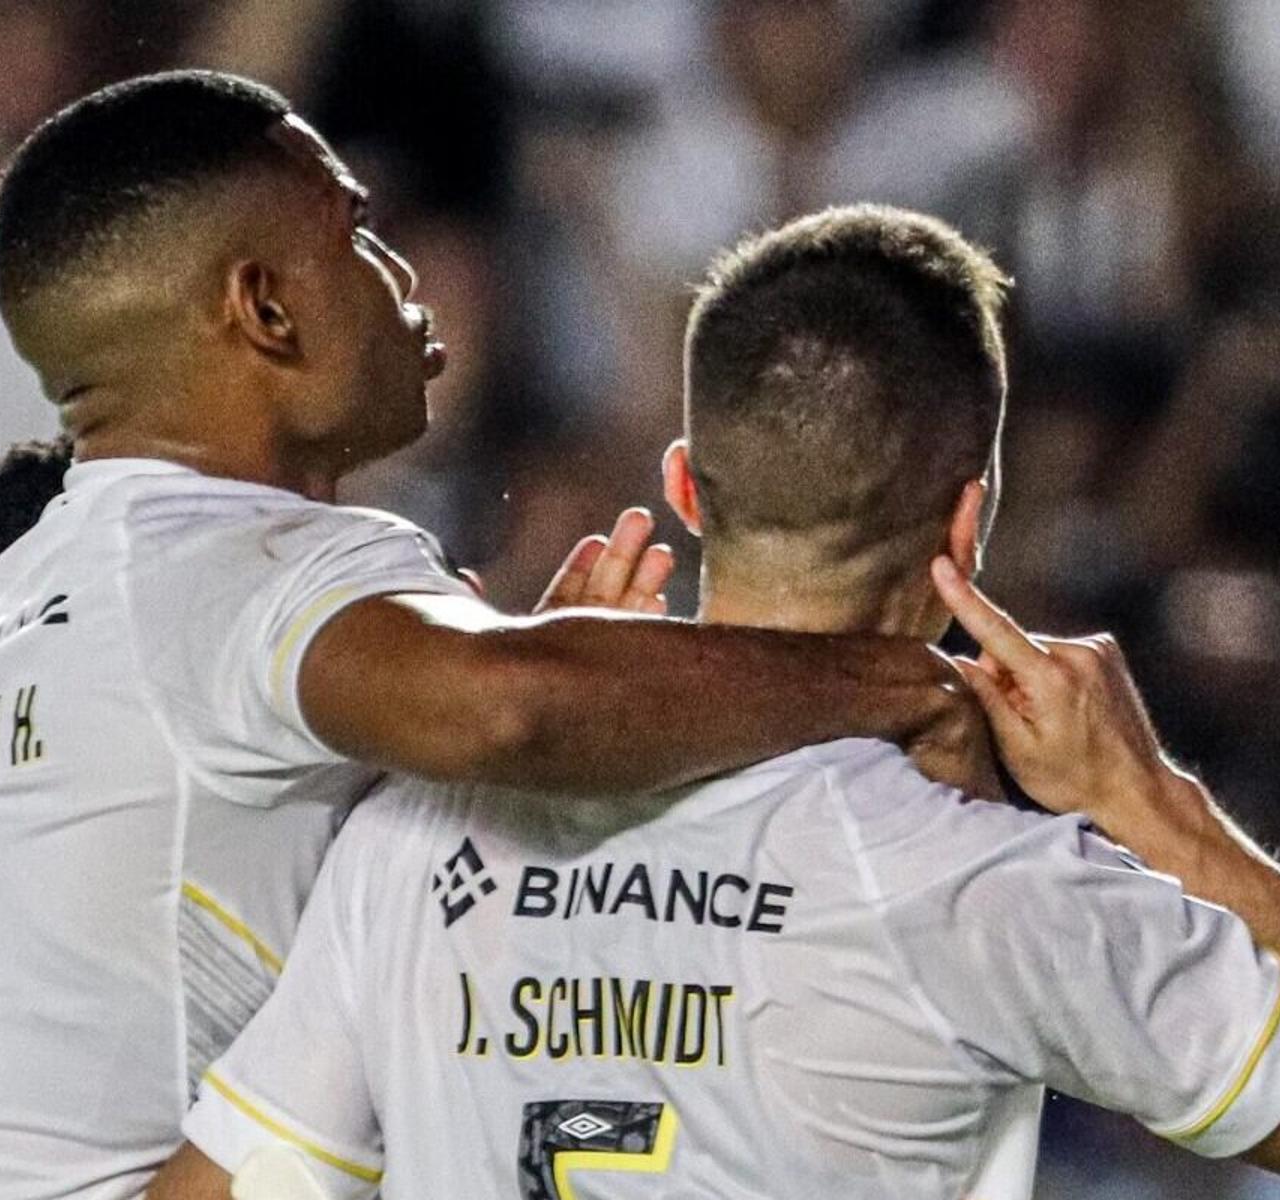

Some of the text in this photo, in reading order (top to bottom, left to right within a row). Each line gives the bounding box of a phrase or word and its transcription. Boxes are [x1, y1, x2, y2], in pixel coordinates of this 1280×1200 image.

[10, 684, 43, 766] H.
[513, 863, 795, 934] BINANCE
[456, 972, 736, 1069] J. SCHMIDT
